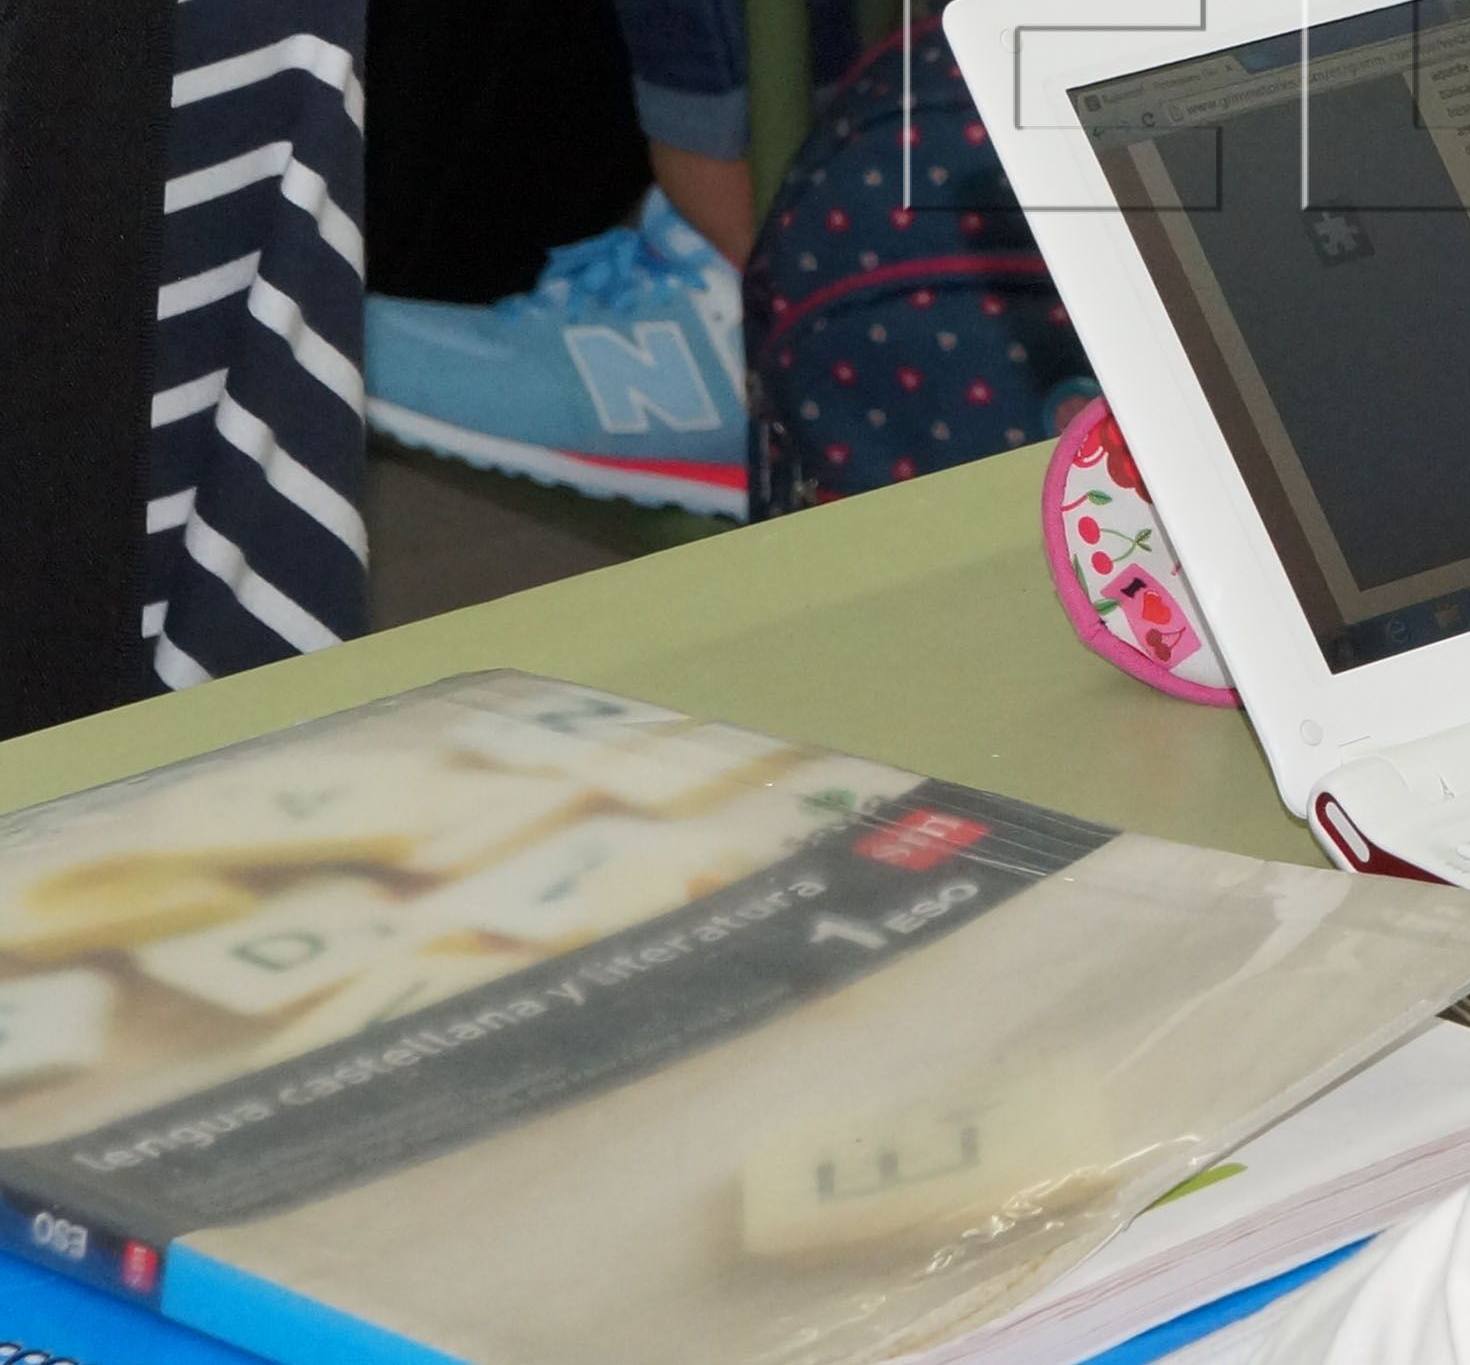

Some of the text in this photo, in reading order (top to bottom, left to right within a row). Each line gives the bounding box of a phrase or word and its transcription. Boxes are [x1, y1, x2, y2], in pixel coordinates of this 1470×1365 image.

[564, 320, 723, 433] N
[810, 882, 980, 950] 1 ESO
[33, 1211, 88, 1260] ESO
